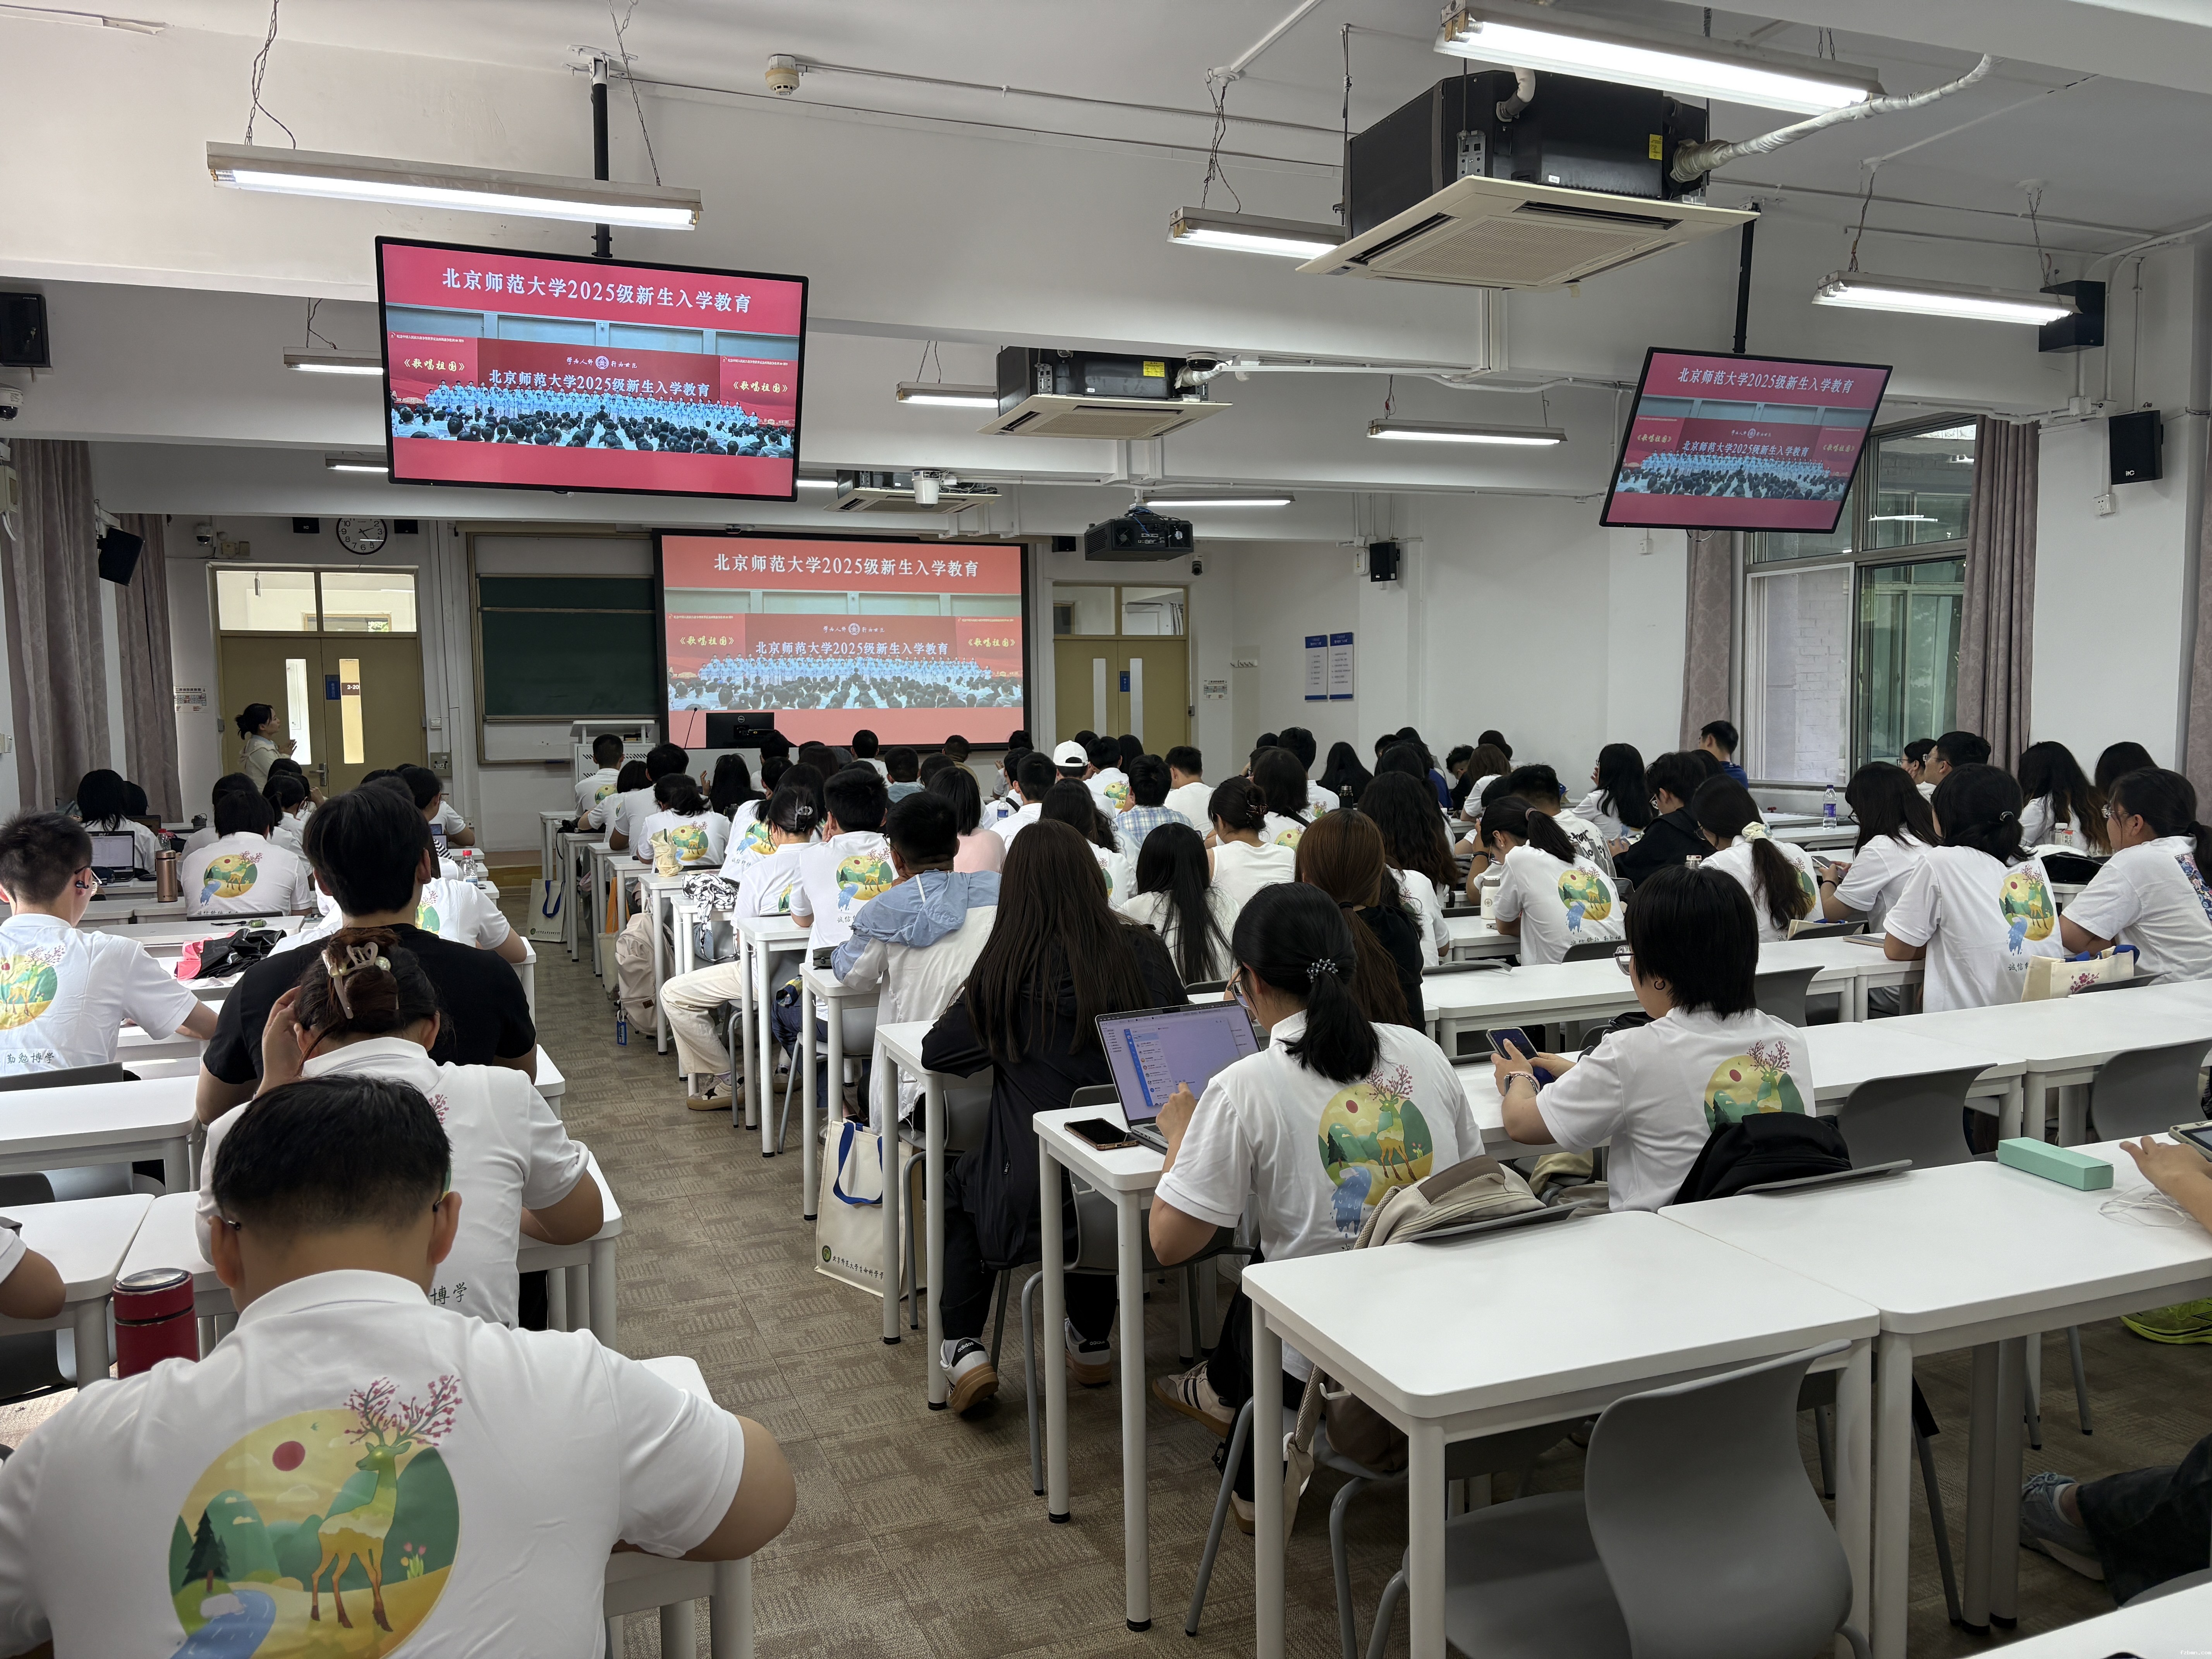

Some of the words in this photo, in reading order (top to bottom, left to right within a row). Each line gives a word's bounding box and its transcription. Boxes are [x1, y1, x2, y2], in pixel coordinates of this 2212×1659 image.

[442, 267, 751, 314] 北京师范大学2025级新生入学教育
[404, 358, 465, 372] 《歌唱祖国》
[489, 369, 710, 397] 北京师范大学2025级新生入学教育
[733, 381, 788, 393] 《歌唱祖国》
[1678, 367, 1854, 394] 北京师范大学2025级新生入学教育
[1682, 440, 1809, 457] 北京师范大学2025级新生入学教育
[714, 553, 979, 577] 北京师范大学2025级新生入学教育
[680, 635, 734, 646] 《歌唱祖国》
[756, 641, 948, 655] 北京师范大学2025级新生入学教育
[7, 1052, 54, 1064] 勤勉博学
[429, 1282, 467, 1305] 博学
